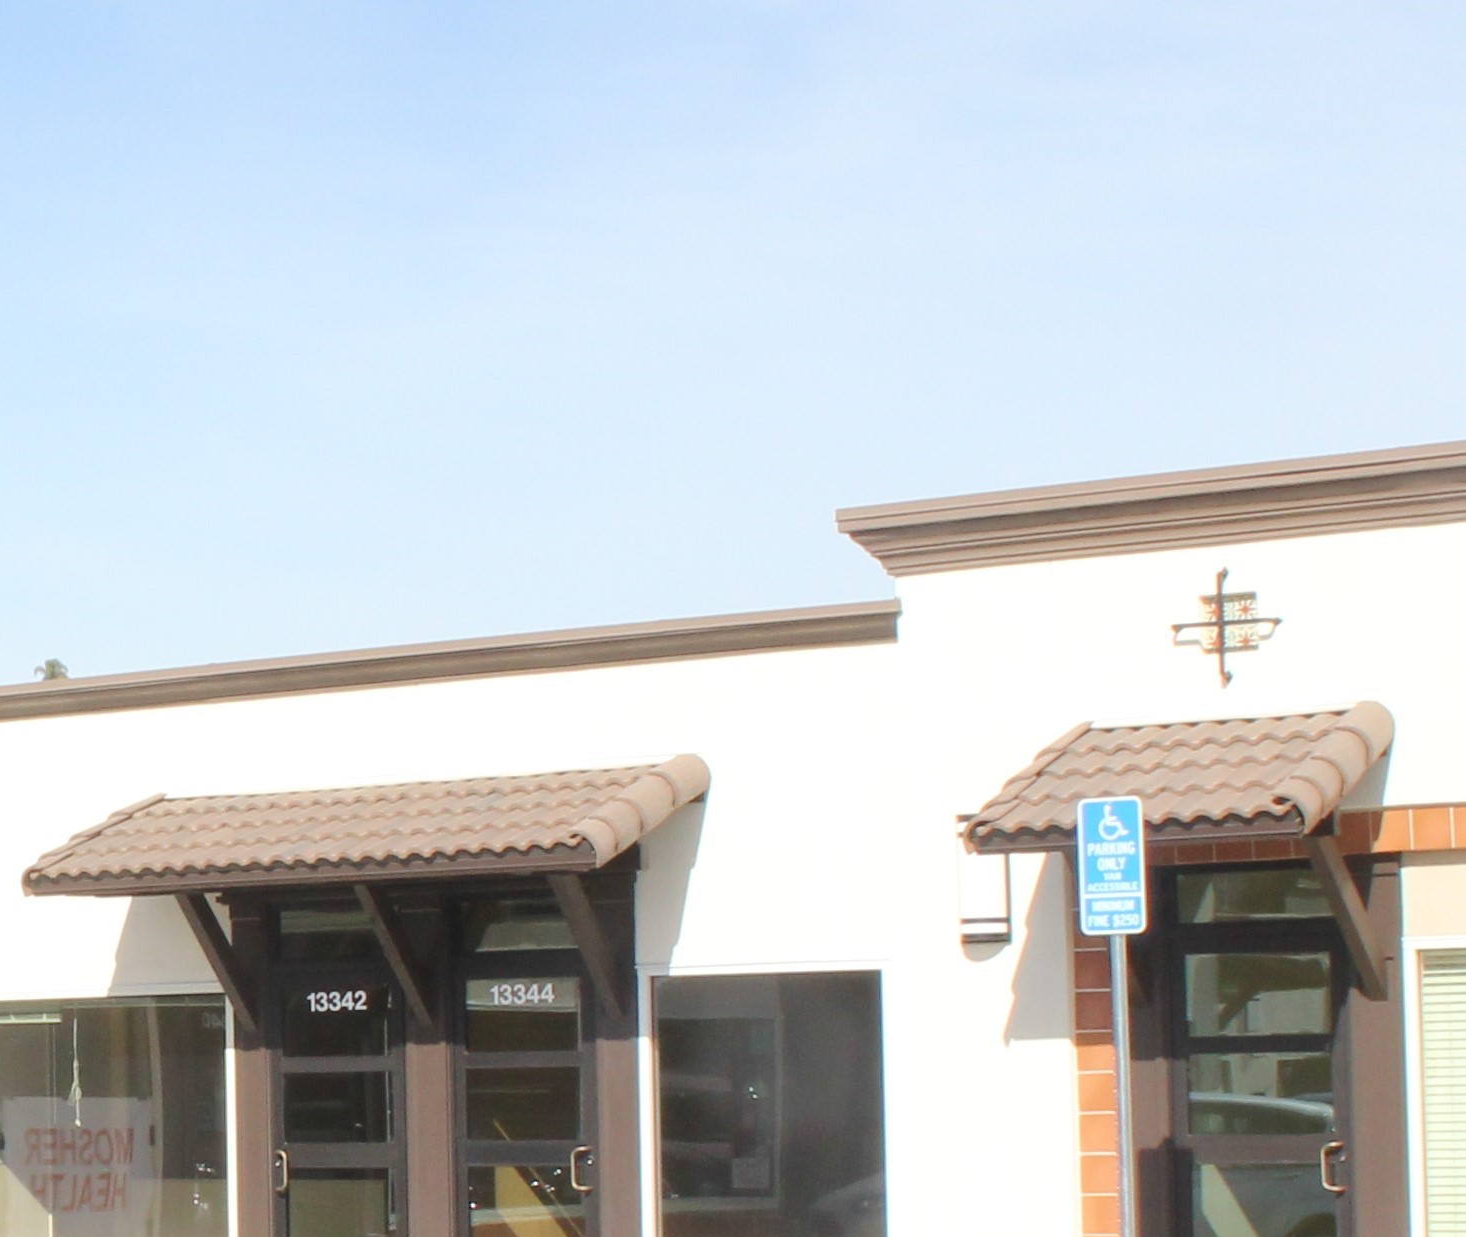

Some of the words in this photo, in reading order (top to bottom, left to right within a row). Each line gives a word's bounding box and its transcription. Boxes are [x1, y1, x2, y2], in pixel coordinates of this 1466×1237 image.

[1087, 841, 1136, 856] PARKING
[1096, 857, 1126, 871] ONLY
[1087, 915, 1110, 927] FINE
[307, 990, 368, 1012] 13342
[490, 983, 555, 1005] 13344
